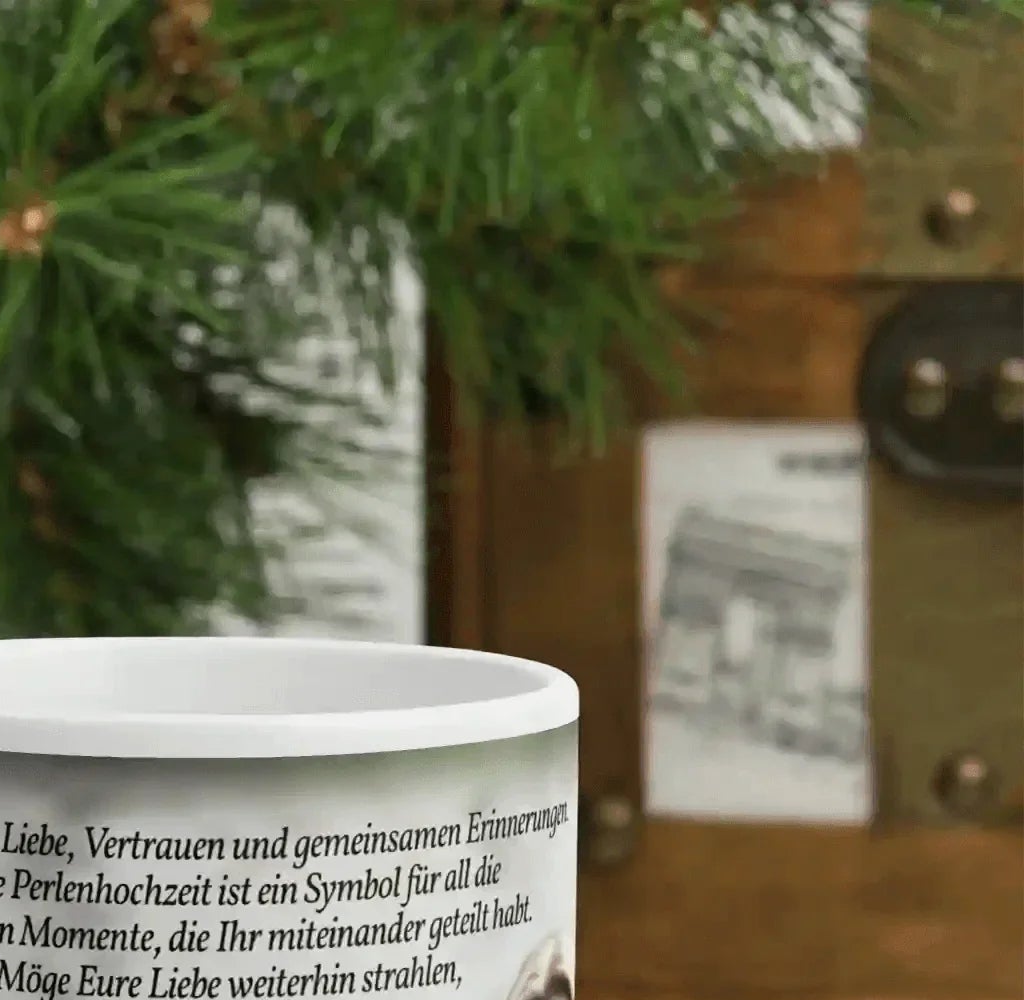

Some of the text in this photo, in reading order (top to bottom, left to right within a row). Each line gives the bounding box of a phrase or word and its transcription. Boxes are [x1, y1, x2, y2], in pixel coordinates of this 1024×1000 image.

[0, 821, 75, 865] Liebe,
[84, 826, 226, 861] Vertrauen
[232, 825, 289, 861] und
[291, 821, 462, 871] gemeinsamen
[10, 867, 213, 907] Perlenhochzeit
[217, 873, 253, 907] ist
[256, 872, 298, 906] ein
[303, 864, 403, 915] Symbol
[399, 863, 443, 909] für
[443, 856, 472, 893] all
[473, 853, 503, 889] die
[18, 914, 162, 961] Momente,
[167, 919, 211, 953] die
[215, 919, 264, 953] Ihr
[267, 910, 427, 952] miteinander
[427, 899, 491, 952] geteilt
[491, 892, 533, 931] habt.
[75, 964, 143, 999] Eure
[147, 965, 223, 1000] Liebe
[227, 961, 357, 1000] weiterhin
[360, 953, 463, 994] strahlen,
